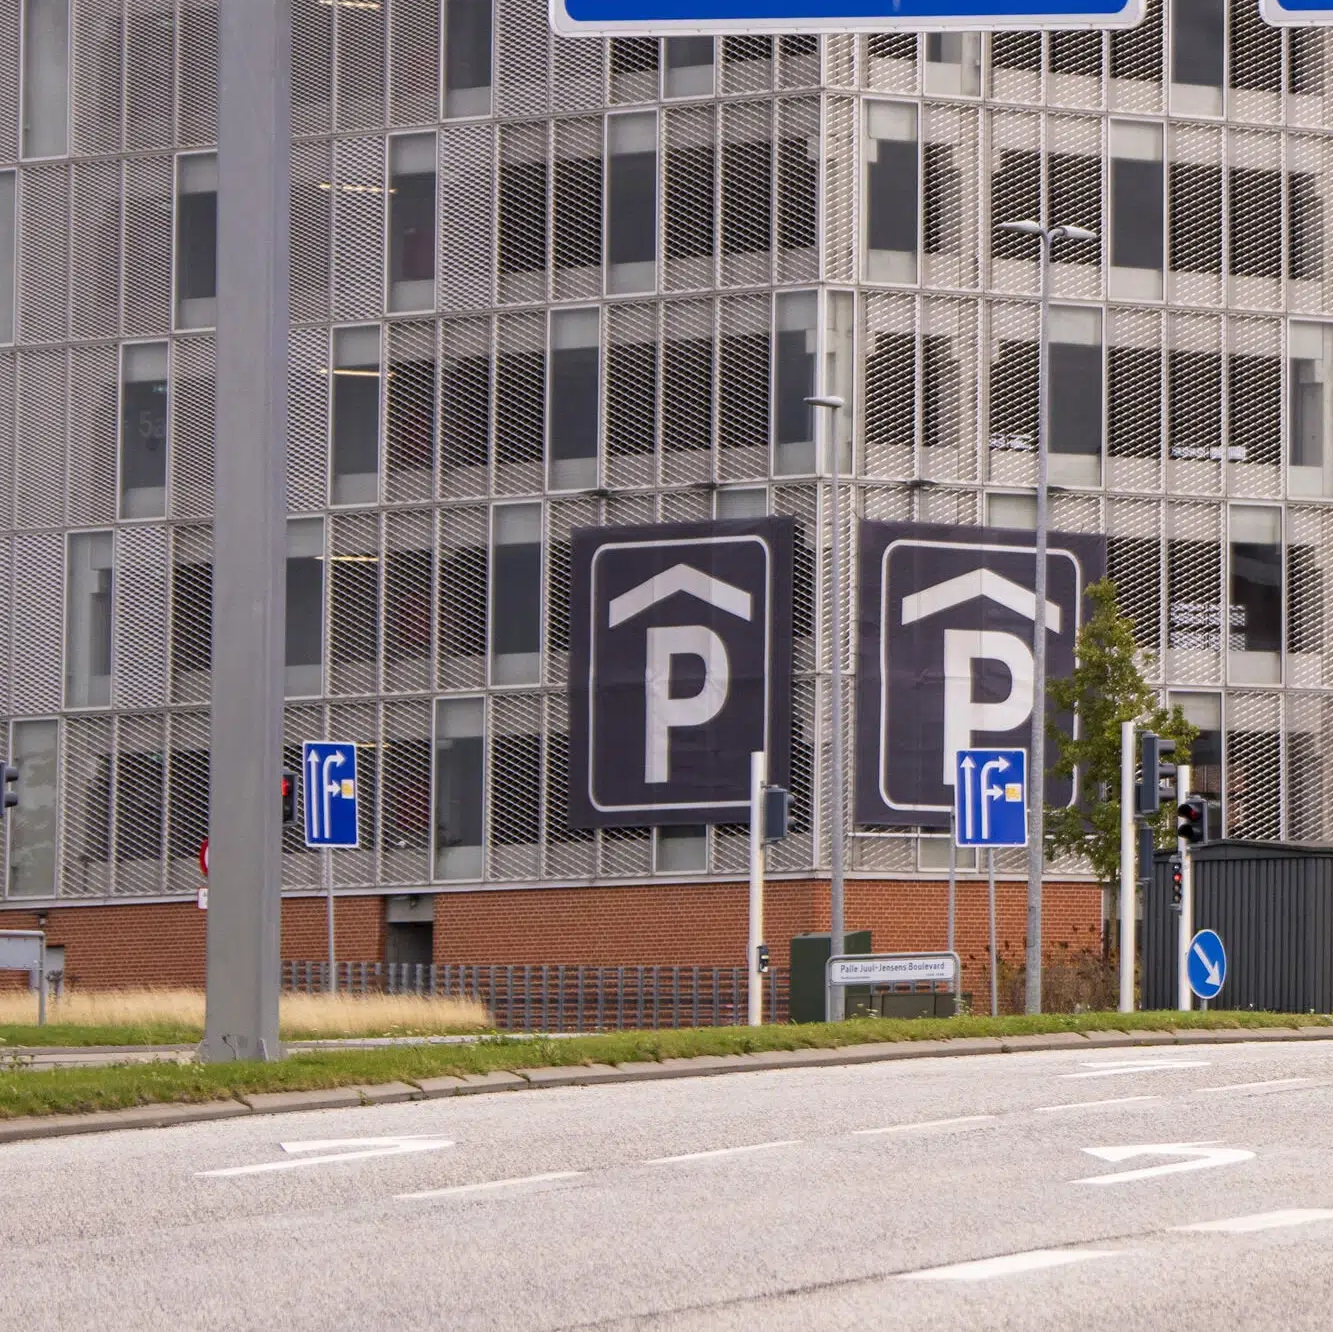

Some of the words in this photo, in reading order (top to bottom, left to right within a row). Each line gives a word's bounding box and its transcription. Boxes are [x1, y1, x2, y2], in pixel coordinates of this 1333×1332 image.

[645, 624, 730, 784] P
[943, 628, 1034, 786] P
[840, 964, 858, 973] Palle
[860, 963, 907, 973] Juul-Jensens
[908, 961, 945, 971] Boulevard
